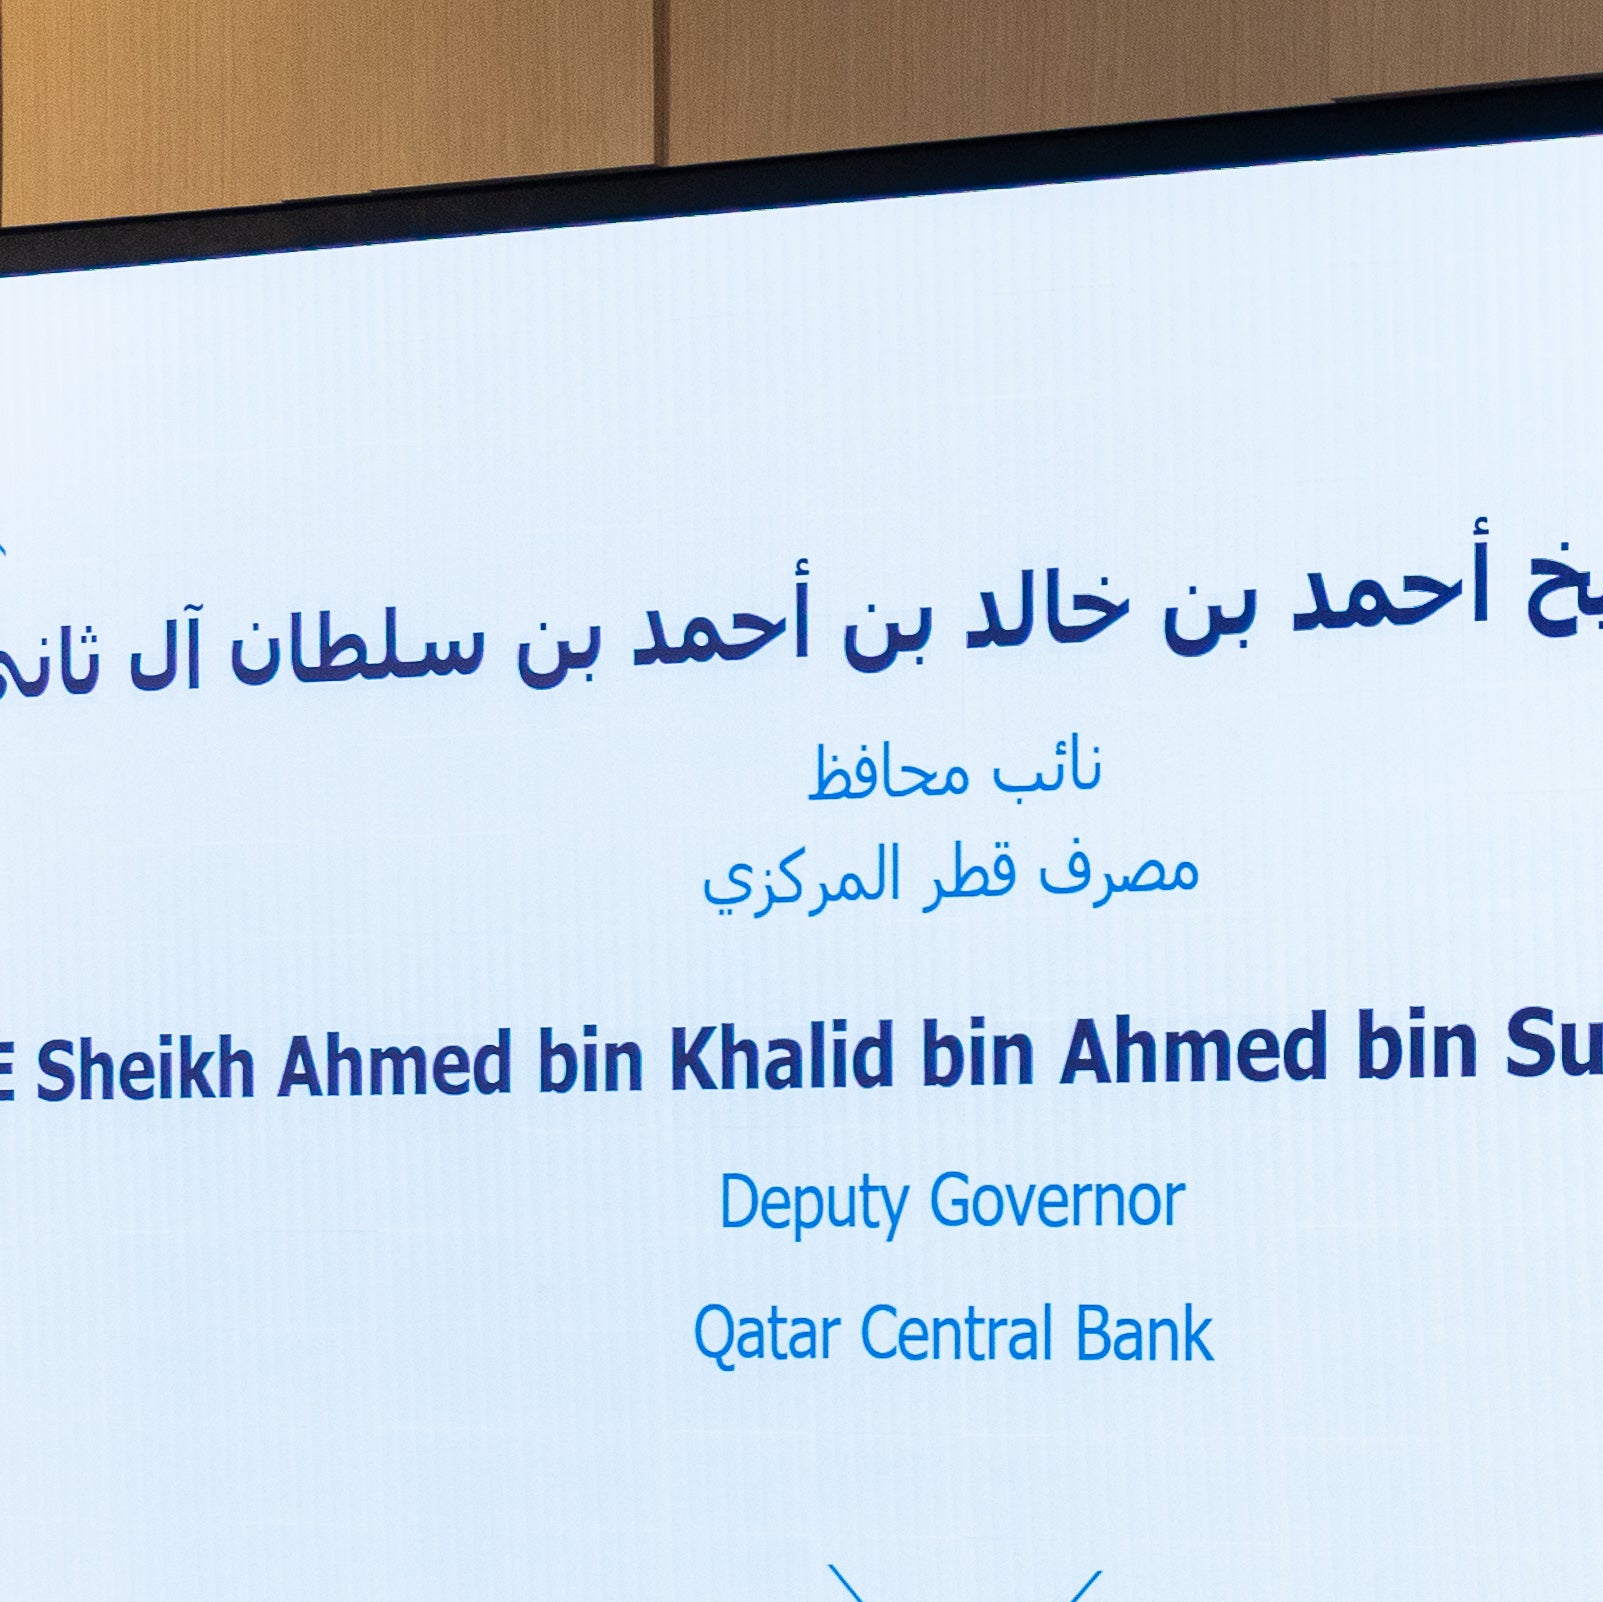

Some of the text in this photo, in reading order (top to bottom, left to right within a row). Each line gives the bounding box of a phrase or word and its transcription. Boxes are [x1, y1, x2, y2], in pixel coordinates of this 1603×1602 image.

[633, 558, 810, 666] أحمد
[966, 567, 1130, 649] خالد
[1293, 516, 1489, 631] أحمد
[130, 604, 204, 691] آل
[231, 606, 484, 686] سلطان
[517, 623, 601, 690] بن
[844, 604, 932, 674] بن
[1163, 585, 1257, 657] بن
[808, 732, 1101, 805] نائب محافظ
[704, 837, 1199, 919] مصرف قطر المركزي
[37, 1034, 254, 1102] Sheikh
[277, 1028, 511, 1097] Ahmed
[539, 1024, 642, 1094] bin
[672, 1019, 893, 1090] Khalid
[923, 1016, 1033, 1088] bin
[1059, 1009, 1326, 1084] Ahmed
[1359, 1006, 1476, 1080] bin
[722, 1171, 1187, 1243] Deputy Governor
[694, 1302, 1215, 1372] Qatar Central Bank
